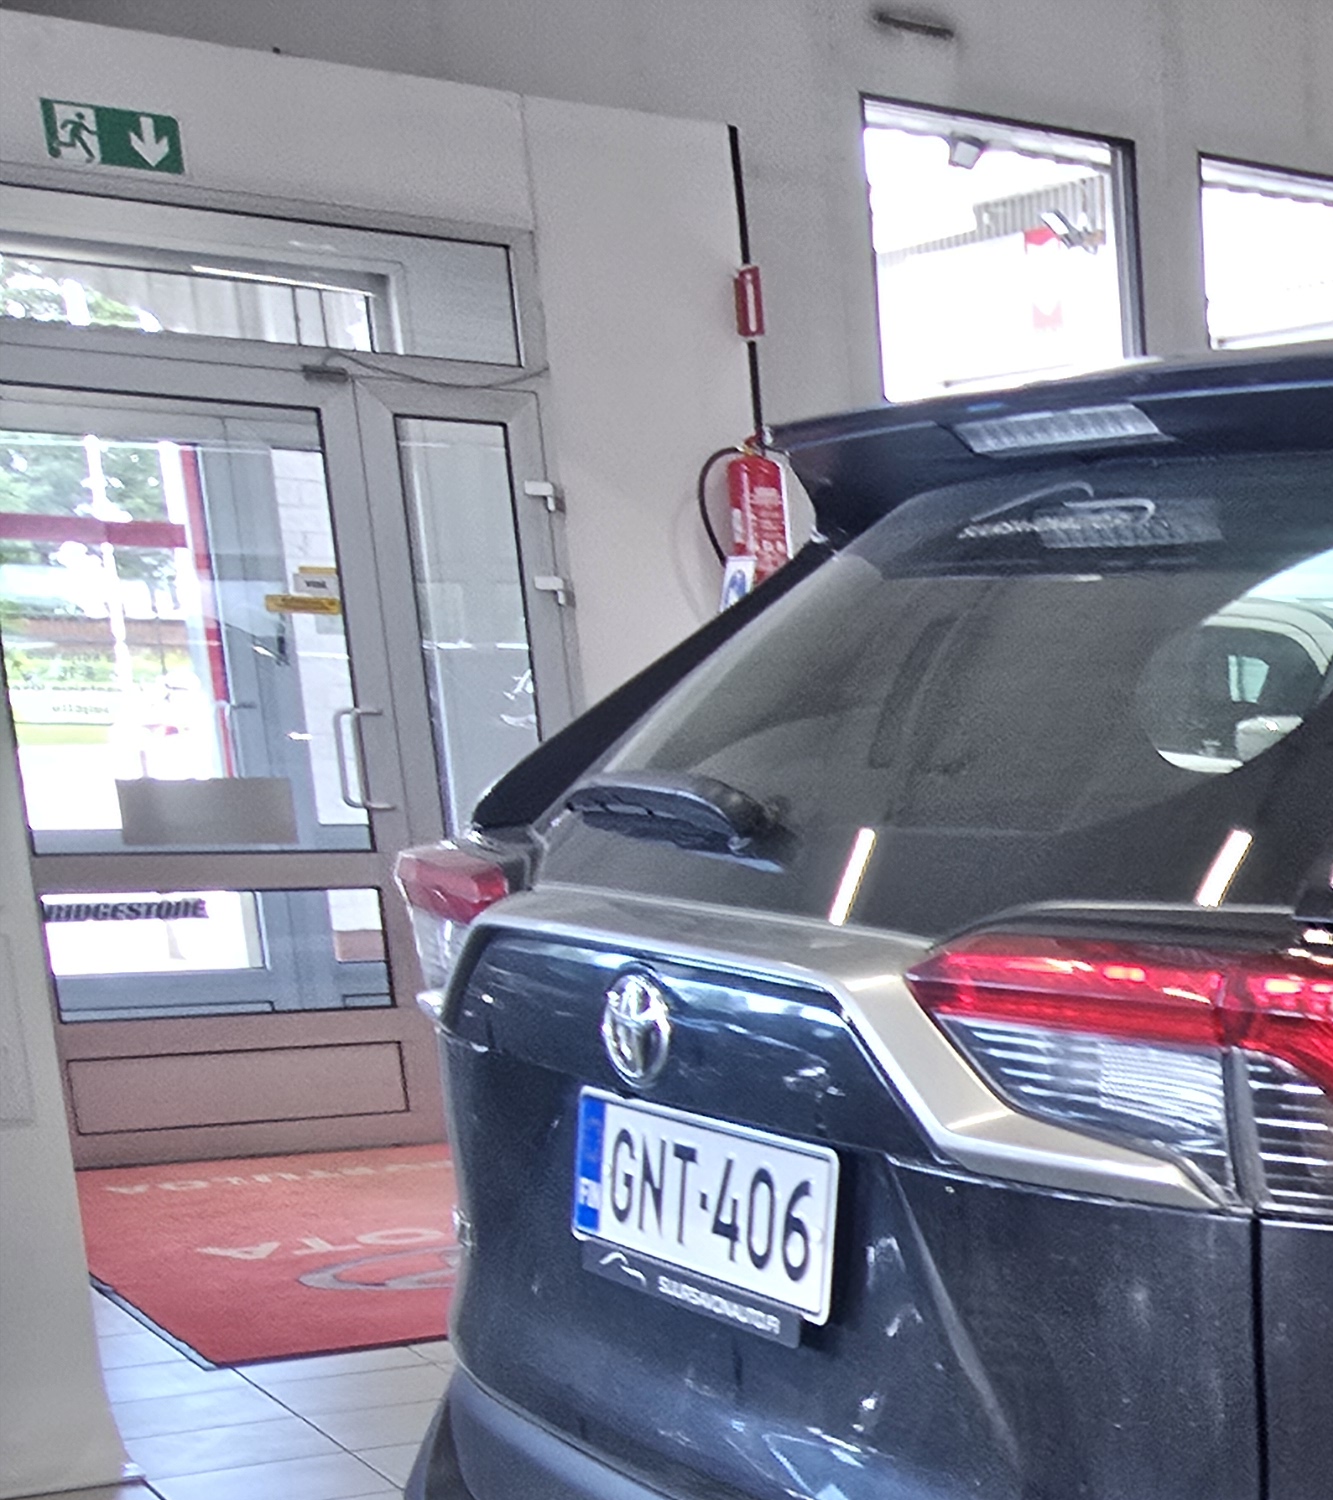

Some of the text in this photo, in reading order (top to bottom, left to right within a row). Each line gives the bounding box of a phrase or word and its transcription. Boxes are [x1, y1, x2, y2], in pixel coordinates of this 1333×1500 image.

[44, 899, 208, 922] RIDGESTONE
[610, 1128, 813, 1282] GNT-406
[195, 1227, 445, 1261] OTA
